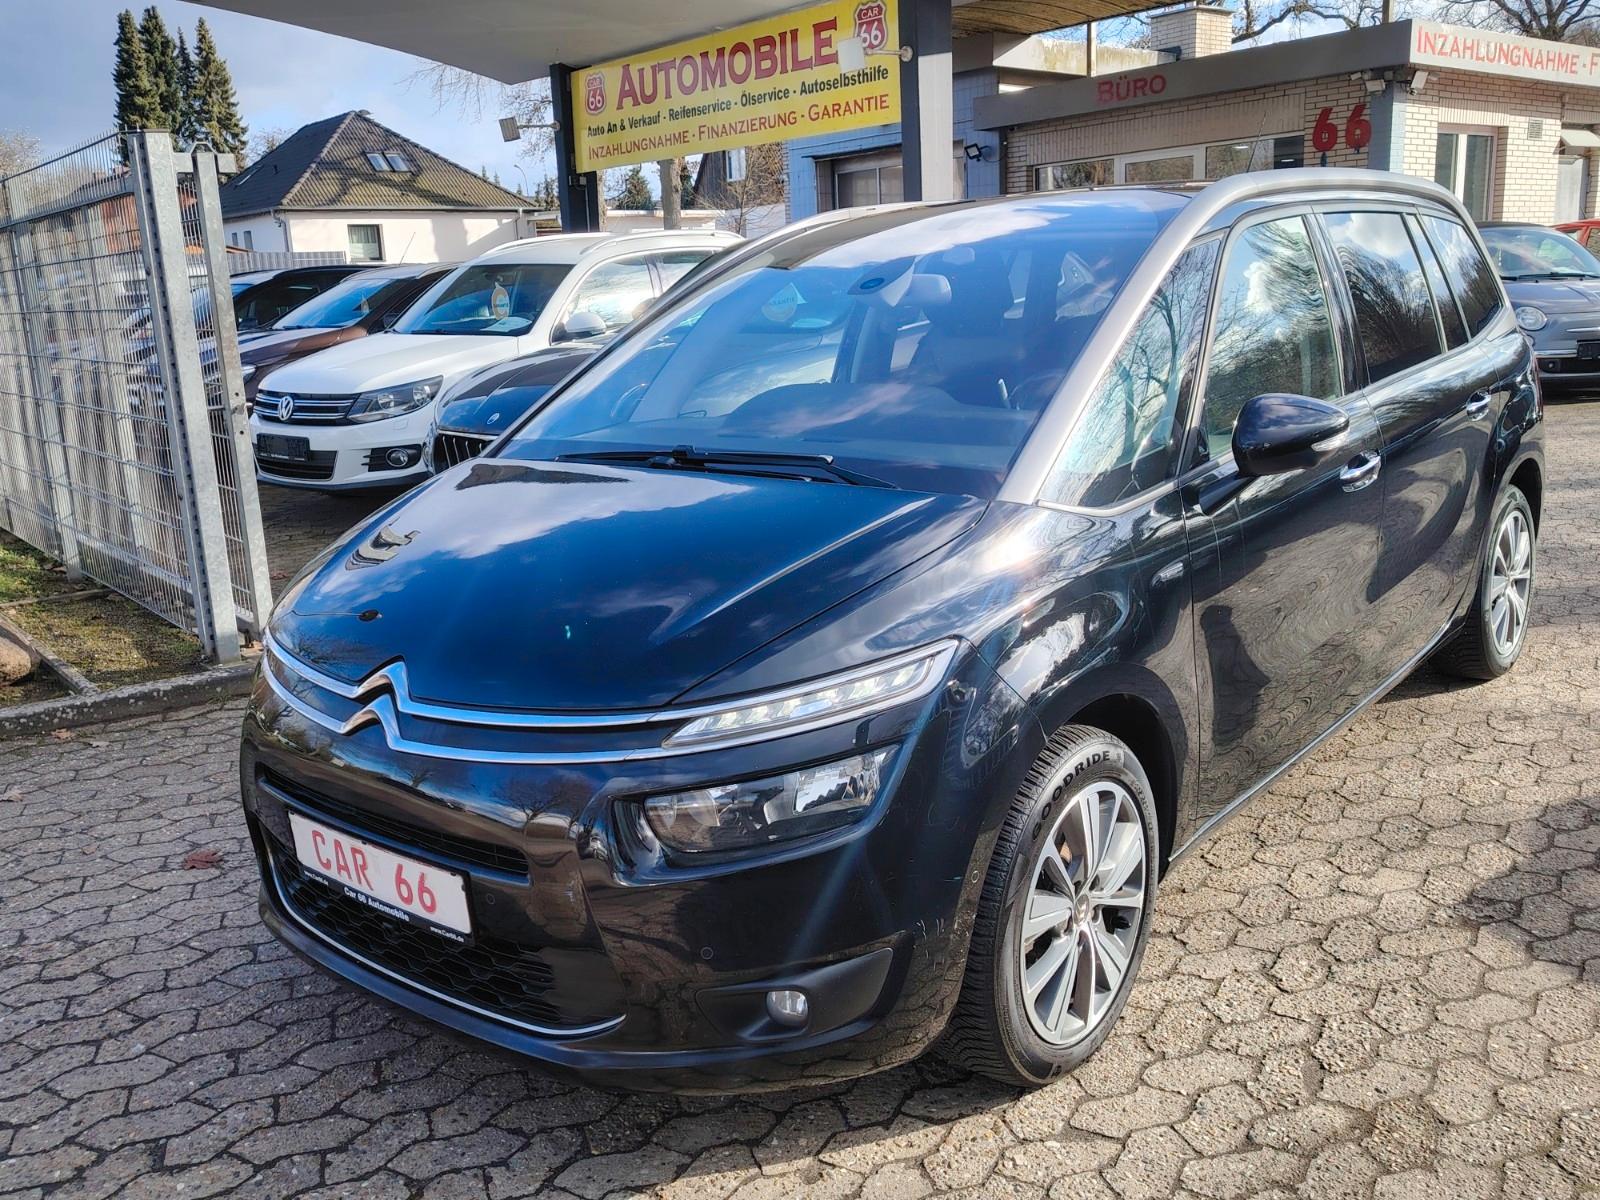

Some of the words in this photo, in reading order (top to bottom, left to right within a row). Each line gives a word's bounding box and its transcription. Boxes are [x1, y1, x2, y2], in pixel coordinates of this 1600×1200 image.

[860, 21, 882, 48] 66
[861, 7, 879, 19] CAR
[616, 16, 839, 111] AUTOMOBILE
[1416, 25, 1580, 75] INZAHLUNGNAHME
[587, 125, 605, 138] Auto
[606, 122, 618, 134] An
[619, 119, 626, 132] &
[628, 111, 661, 129] Verkauf
[668, 98, 732, 122] Reifenservice
[740, 87, 790, 107] Ölservice
[799, 64, 889, 96] Autoselbsthilfe
[589, 89, 603, 110] 66
[1096, 74, 1168, 103] BÜRO
[588, 130, 690, 160] INZAHLUNGNAHME
[698, 110, 797, 141] FINANZIERUNG
[808, 94, 889, 122] GARANTIE
[1312, 103, 1372, 152] 66
[1032, 750, 1111, 841] GOODRIDE
[311, 830, 374, 891] CAR
[394, 863, 437, 914] 66
[344, 886, 356, 898] Car
[368, 898, 410, 922] Automobile
